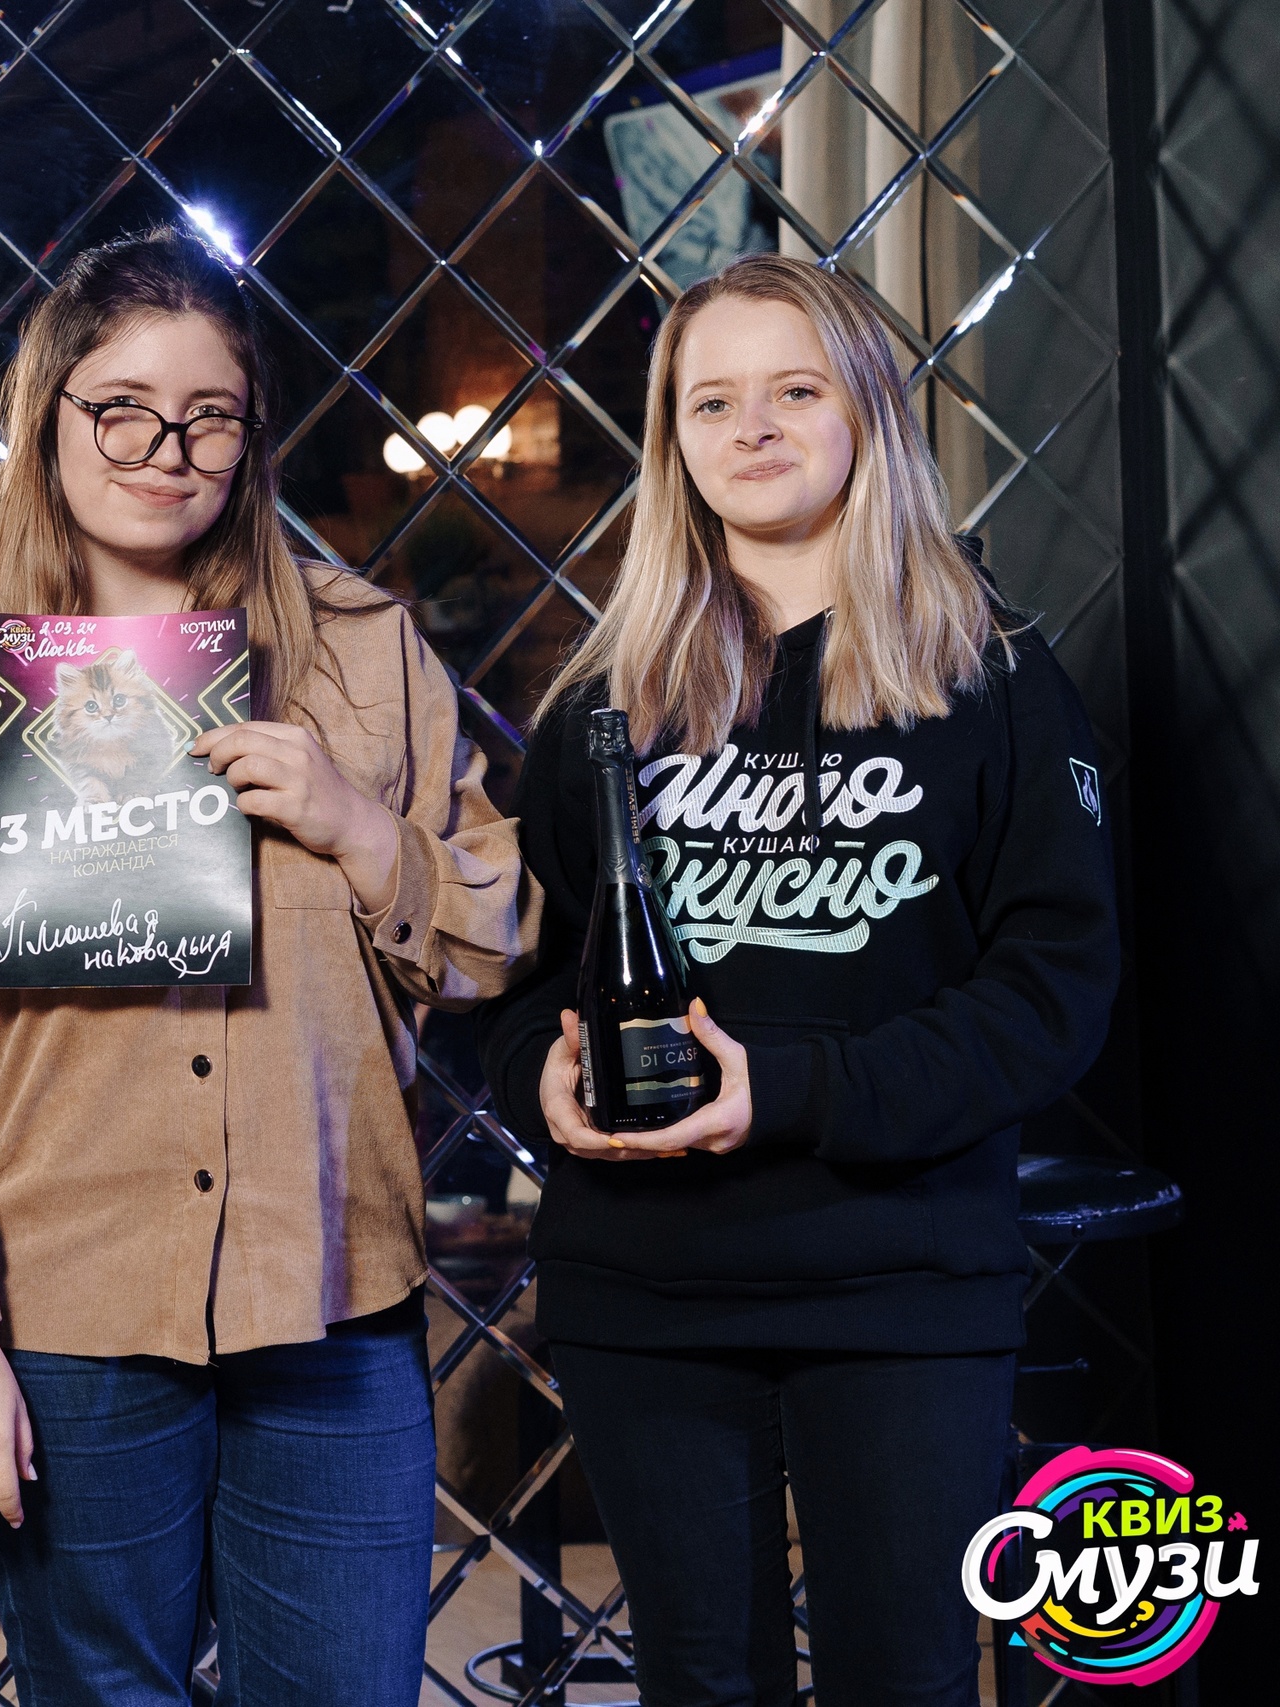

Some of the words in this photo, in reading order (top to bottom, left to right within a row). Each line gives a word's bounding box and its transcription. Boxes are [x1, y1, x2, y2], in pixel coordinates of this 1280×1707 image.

[10, 626, 32, 634] КВИЗ
[39, 621, 97, 636] 2.03.24
[180, 619, 236, 634] КОТИКИ
[24, 637, 100, 662] Москва
[744, 753, 842, 769] КУШЮ
[625, 768, 641, 845] SEMI-SWEET
[0, 813, 29, 855] 3
[41, 785, 230, 850] МЕСТО
[50, 833, 179, 865] НАГРАЖДАЕТСЯ
[723, 836, 820, 854] КУШАЮ
[73, 854, 156, 878] КОМАНДА
[640, 1053, 658, 1068] DI
